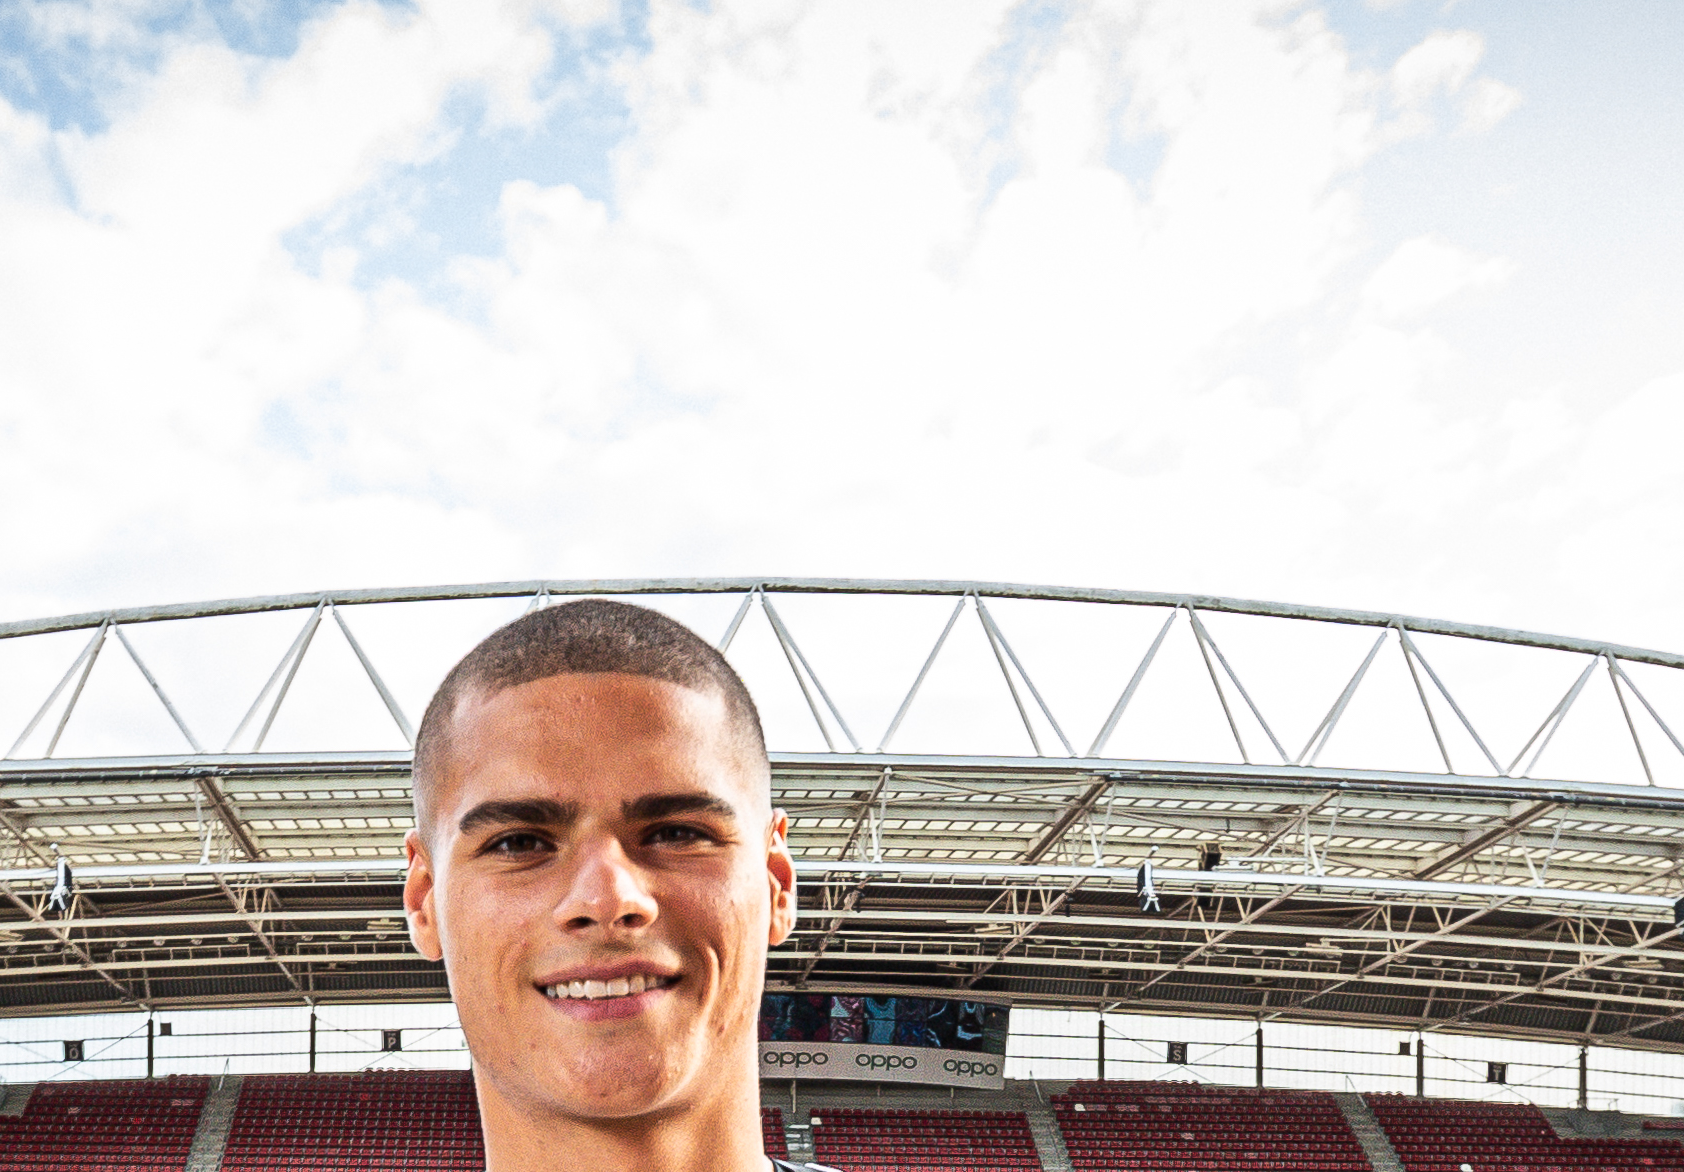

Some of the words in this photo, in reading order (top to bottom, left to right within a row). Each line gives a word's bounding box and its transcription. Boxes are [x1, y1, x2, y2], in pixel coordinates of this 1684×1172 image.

[763, 1050, 829, 1068] oppo
[854, 1053, 918, 1071] oppo
[943, 1058, 998, 1077] oppo
